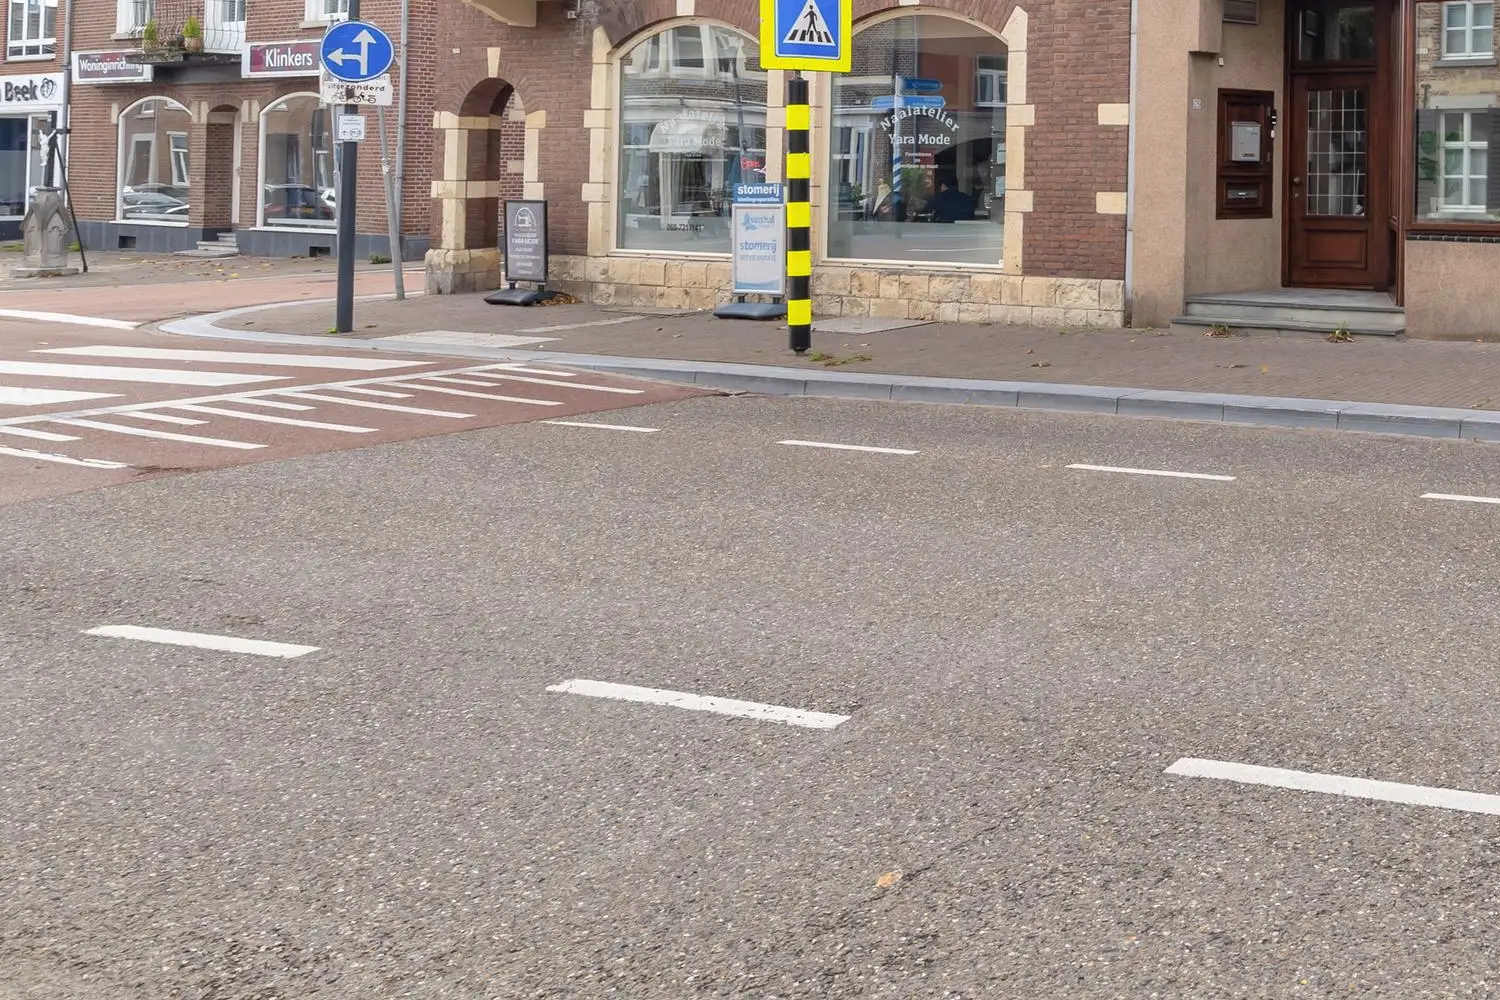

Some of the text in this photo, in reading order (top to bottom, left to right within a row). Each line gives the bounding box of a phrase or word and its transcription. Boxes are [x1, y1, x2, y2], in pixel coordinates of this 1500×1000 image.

[265, 48, 313, 67] Klinkers
[5, 79, 38, 101] Beek
[327, 83, 385, 92] uitgezonderd
[888, 133, 951, 145] Yara Mode
[737, 183, 780, 197] stomerij
[740, 239, 777, 253] stomerij
